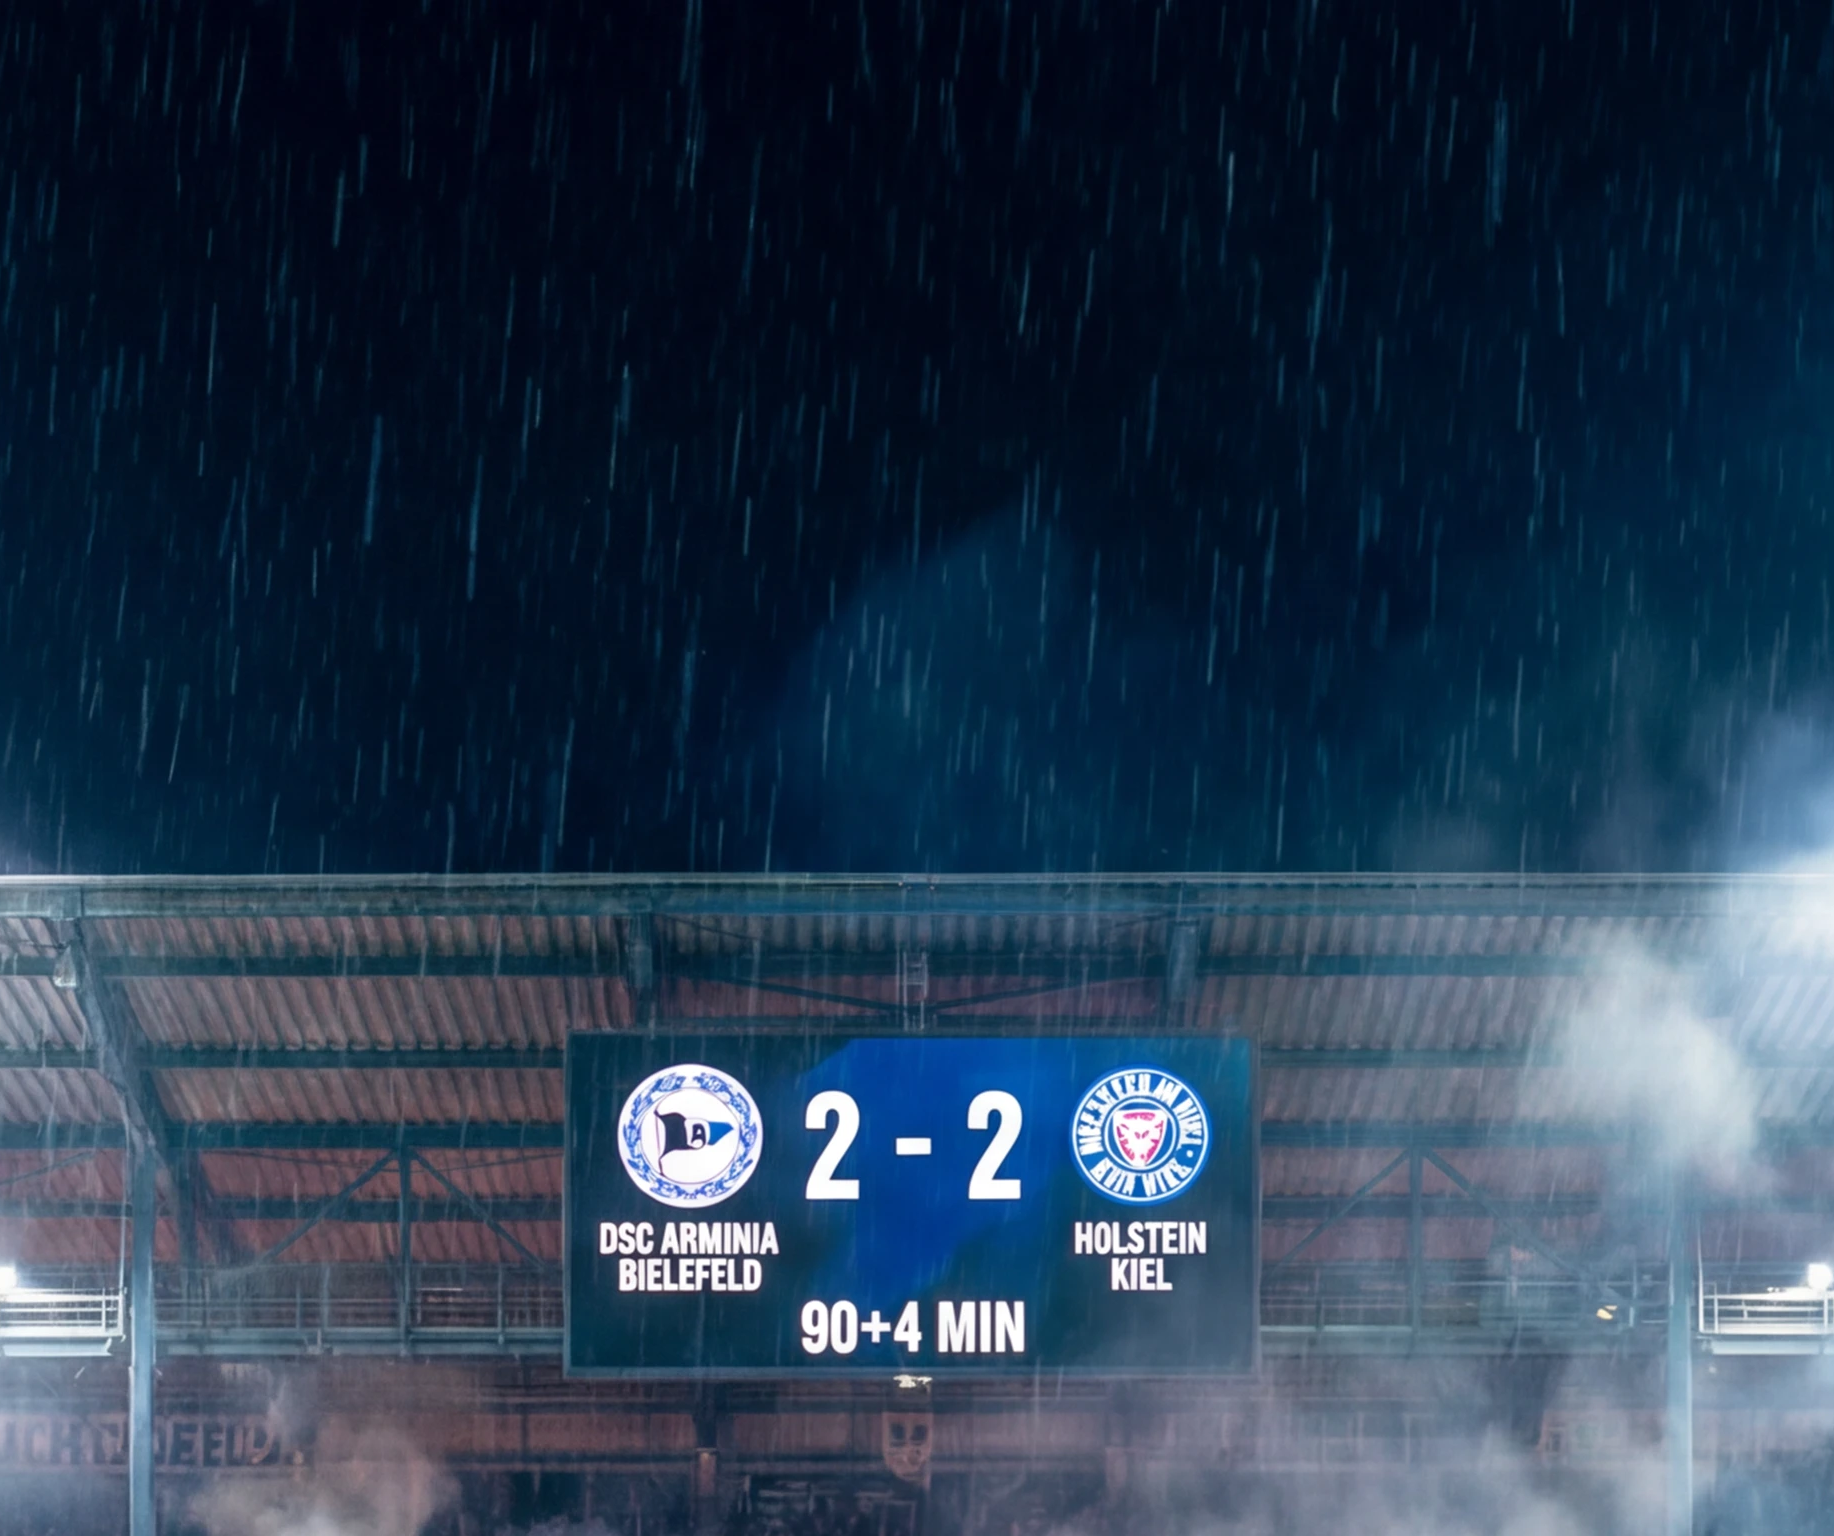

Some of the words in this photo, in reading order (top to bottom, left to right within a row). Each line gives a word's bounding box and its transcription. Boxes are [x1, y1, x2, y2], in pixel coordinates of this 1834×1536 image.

[805, 1090, 860, 1200] 2
[967, 1090, 1023, 1200] 2
[599, 1221, 655, 1255] DSC
[660, 1221, 779, 1255] ARMINIA
[1074, 1221, 1207, 1255] HOLSTEIN
[618, 1257, 762, 1292] BIELEFELD
[1111, 1257, 1173, 1291] KIEL
[801, 1299, 923, 1354] 90+4
[938, 1300, 1025, 1353] MIN
